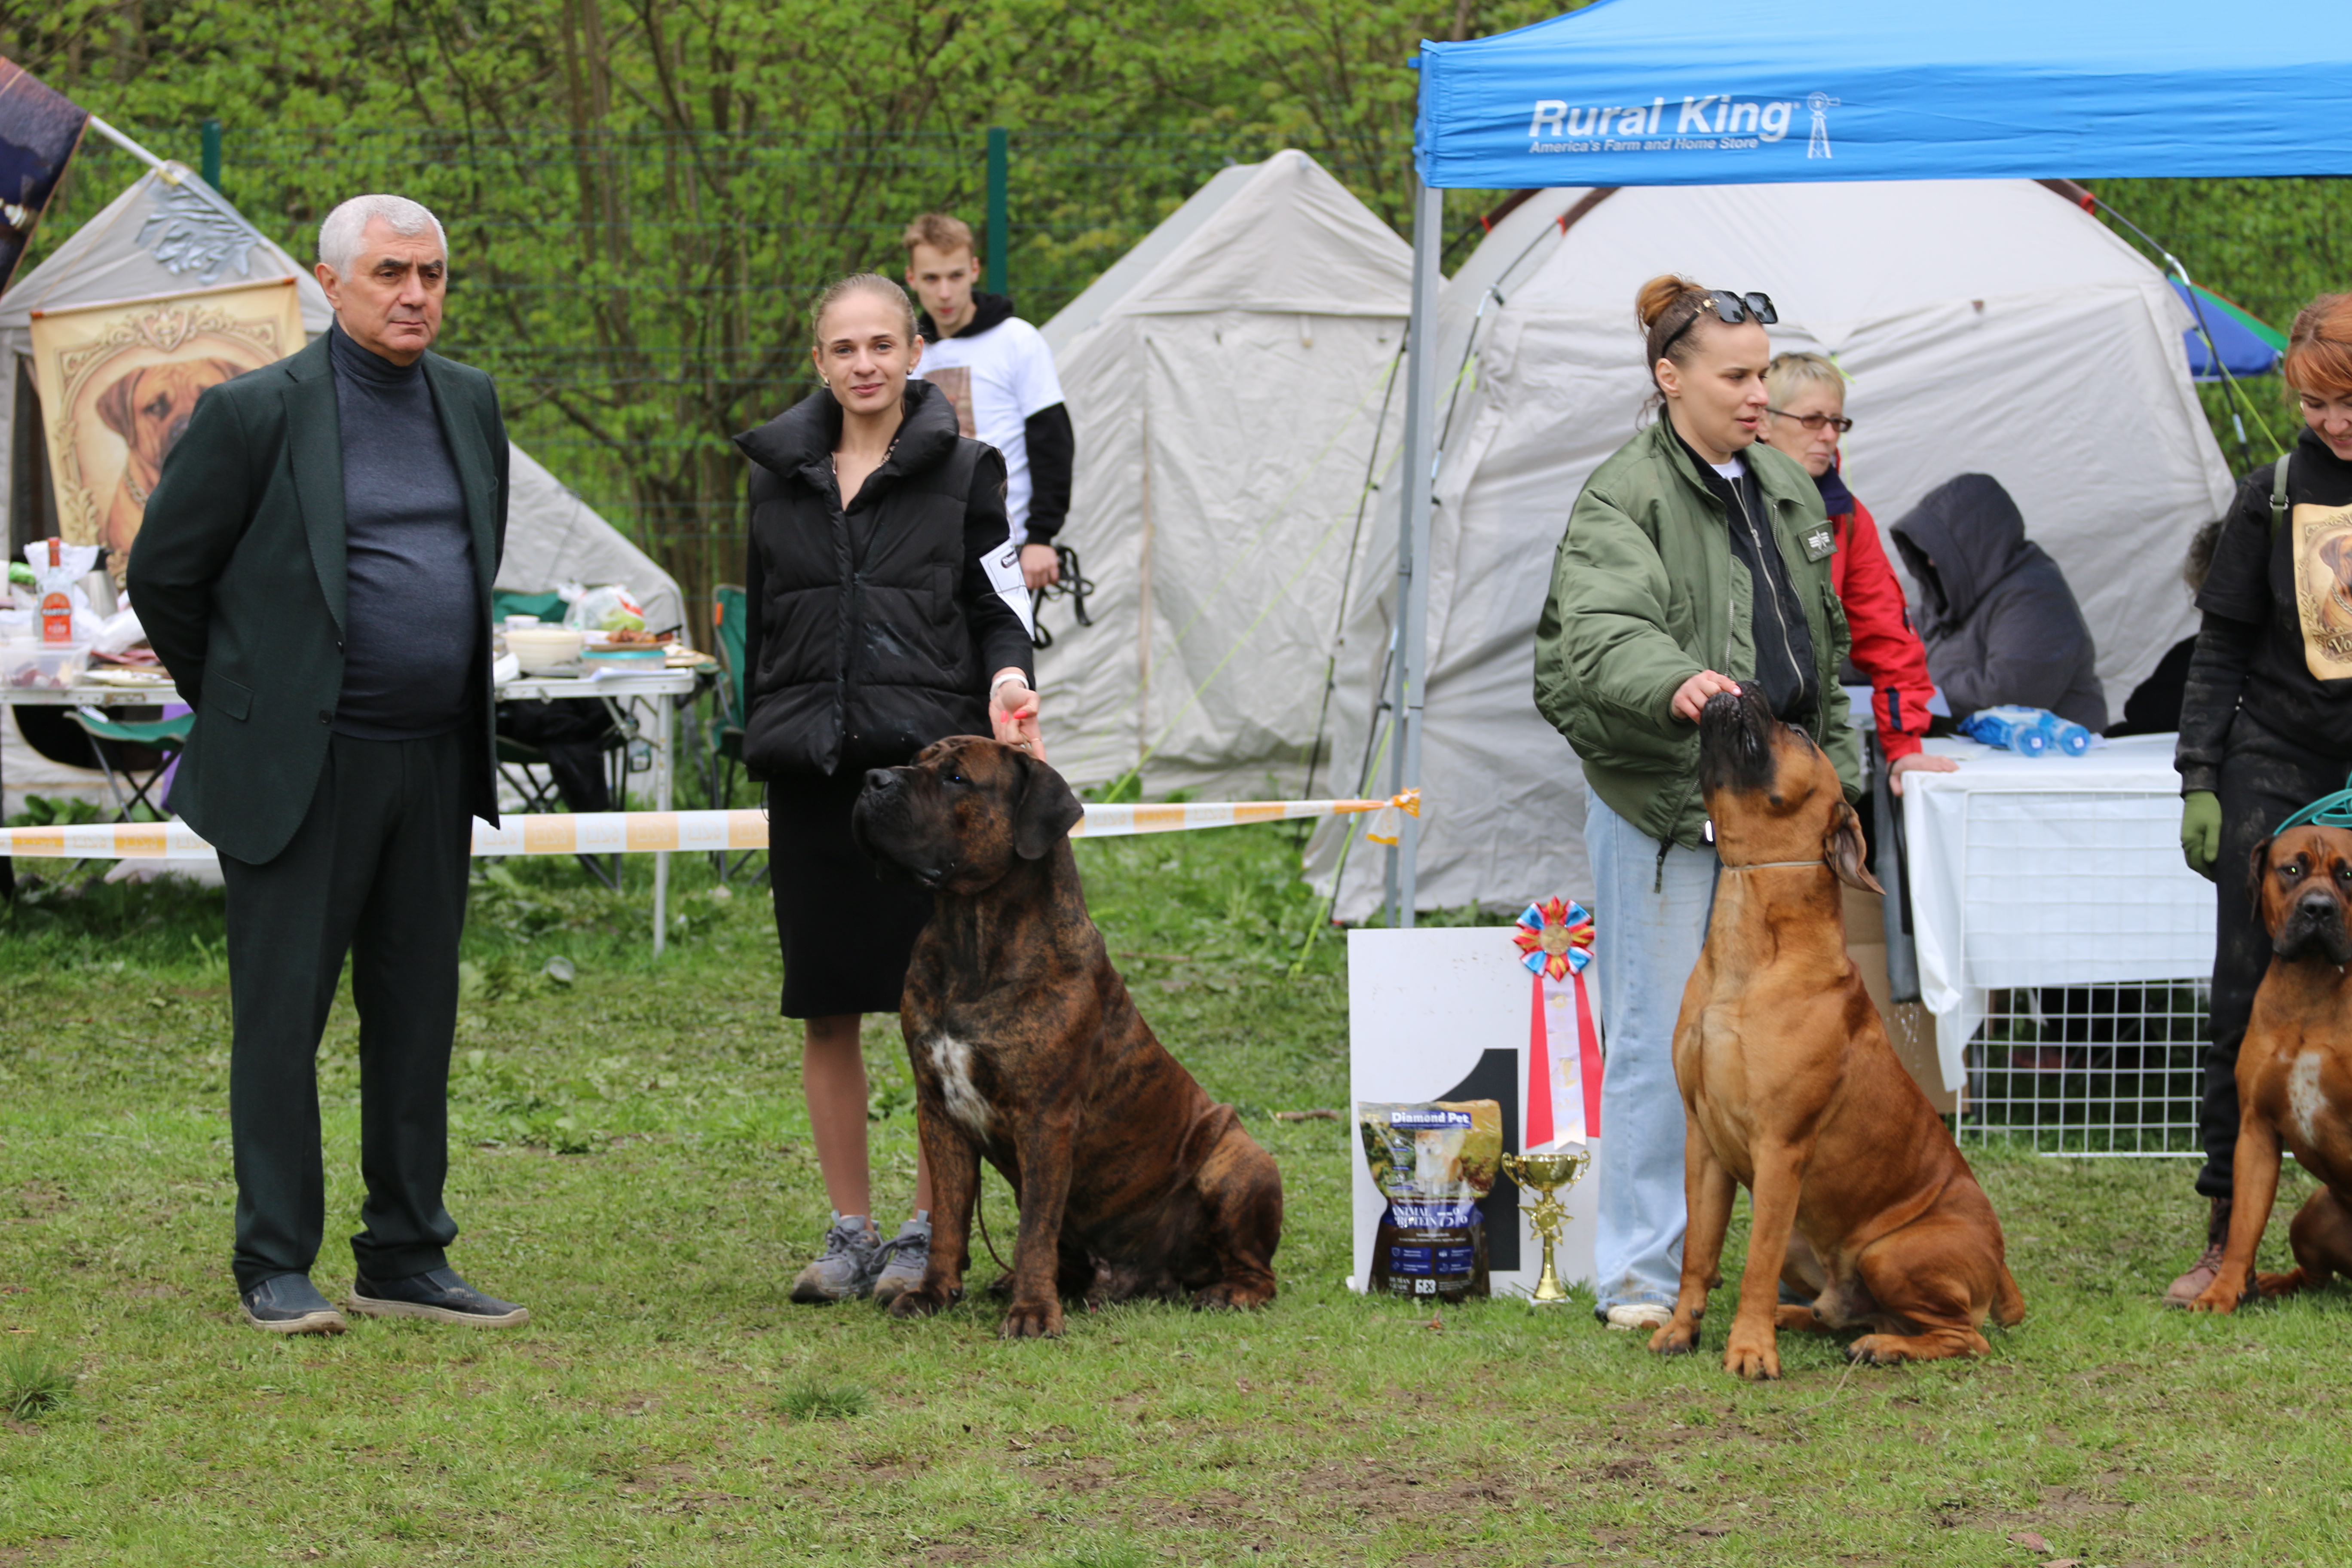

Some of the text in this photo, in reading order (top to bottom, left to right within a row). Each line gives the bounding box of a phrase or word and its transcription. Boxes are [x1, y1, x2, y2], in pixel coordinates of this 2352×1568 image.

[1529, 95, 1792, 141] Rural King
[1530, 136, 1758, 153] America's Farm and Home Store
[2328, 636, 2352, 653] Vo
[1392, 1112, 1469, 1123] Diamond Pet
[1415, 1278, 1436, 1294] БЕЗ
